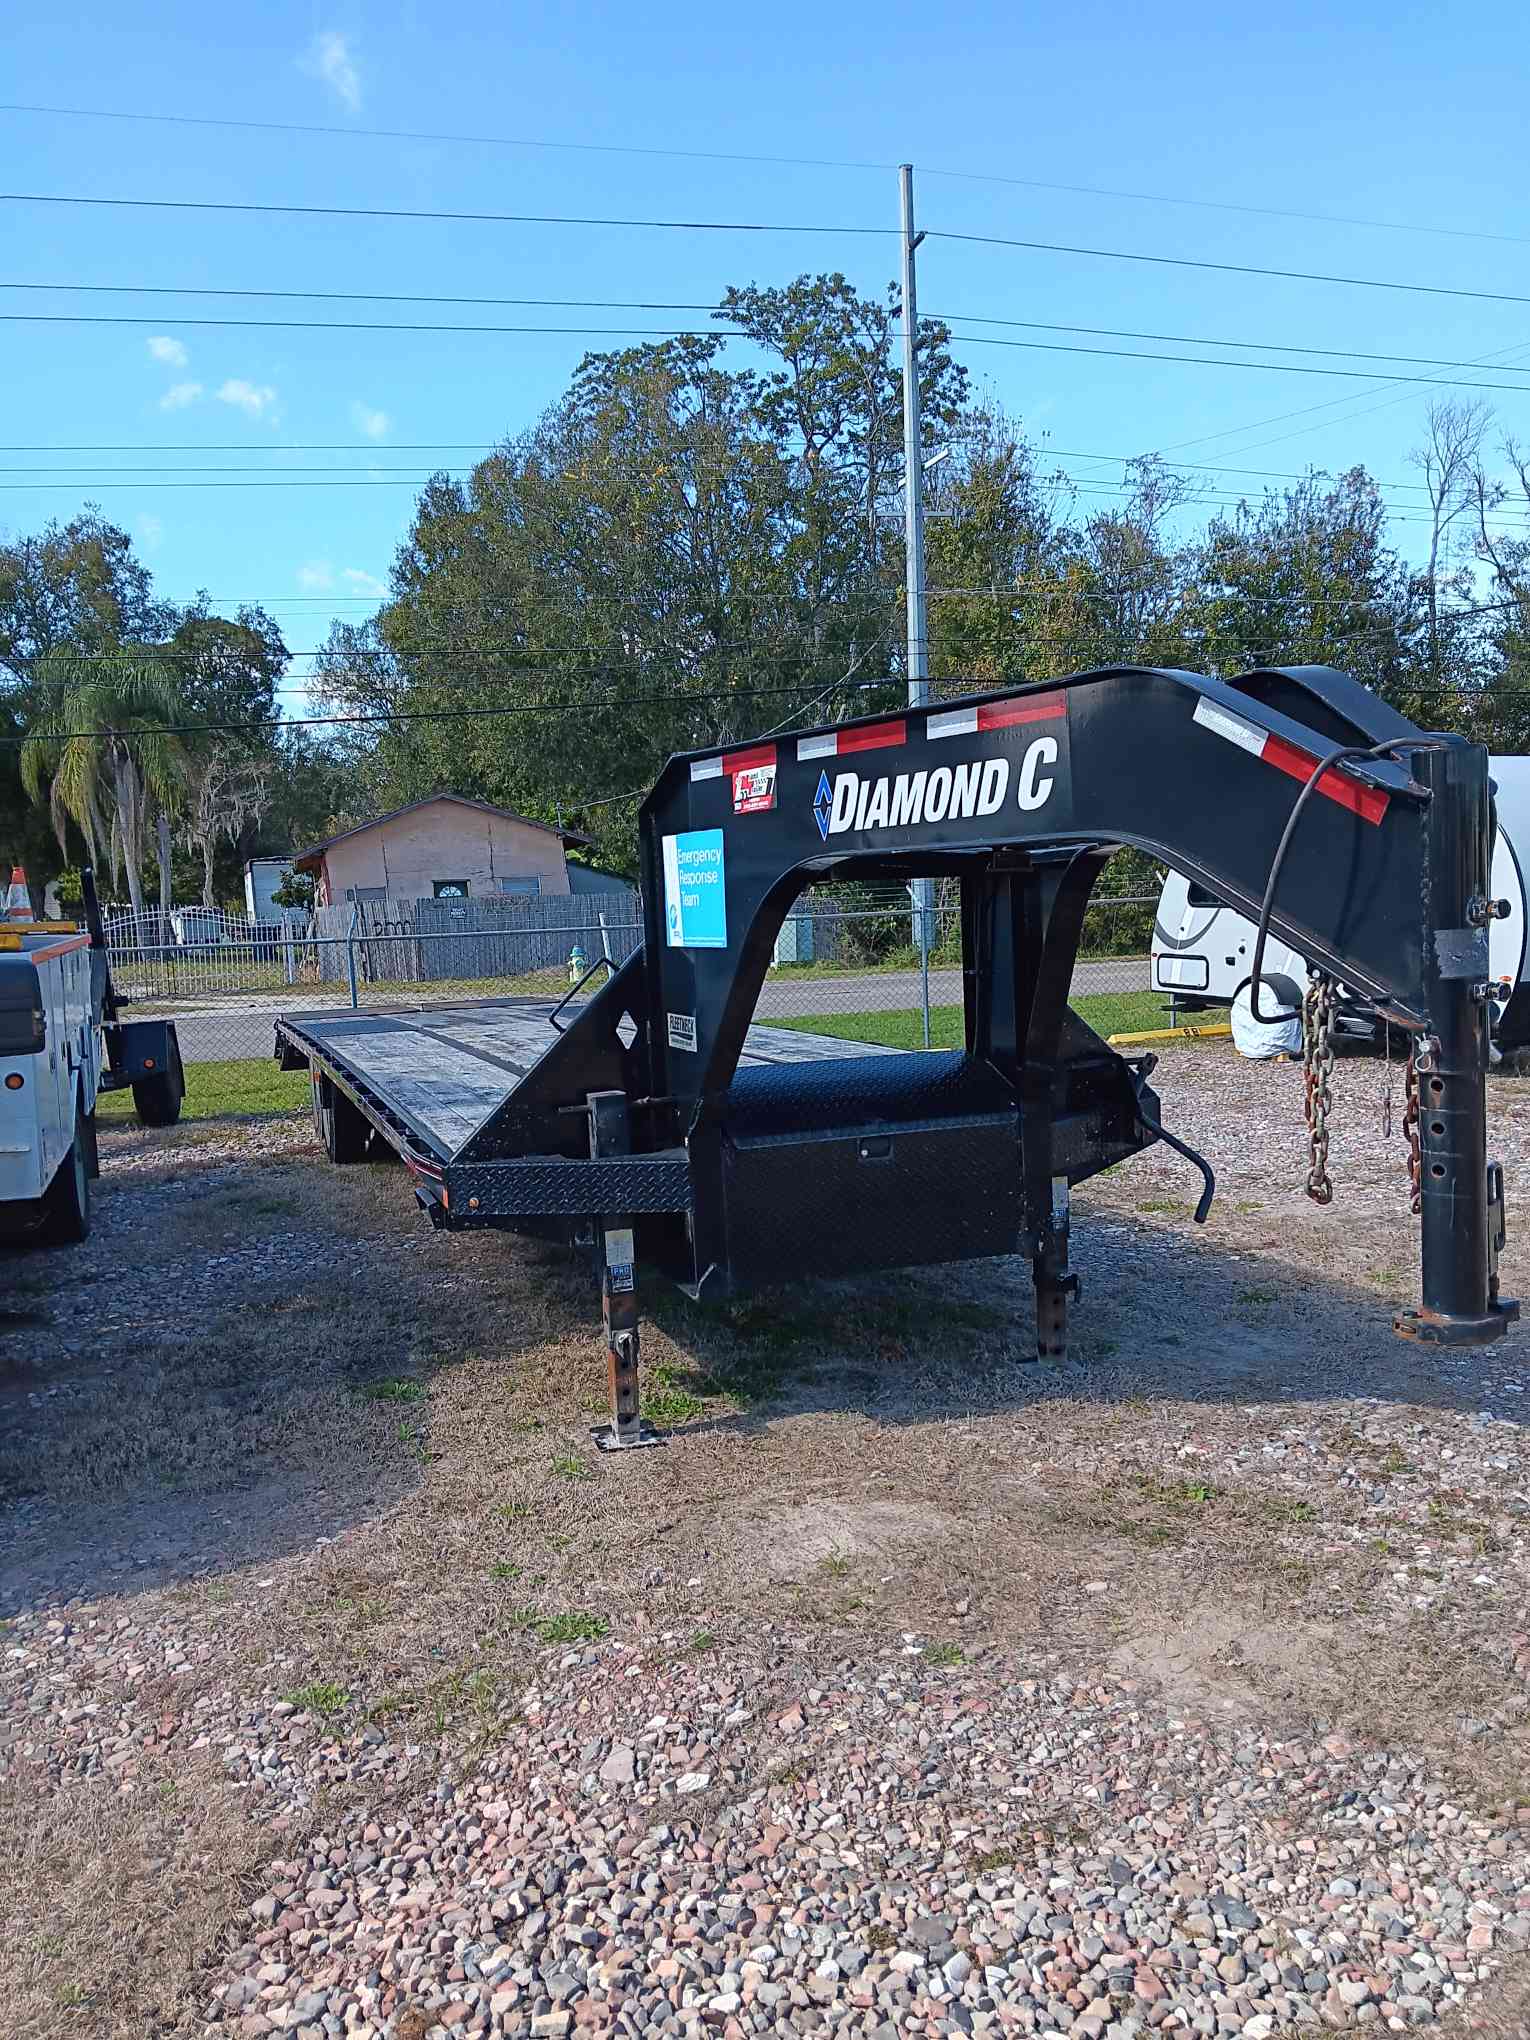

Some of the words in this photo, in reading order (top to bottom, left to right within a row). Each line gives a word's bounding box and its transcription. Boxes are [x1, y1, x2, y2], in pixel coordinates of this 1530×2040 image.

[828, 758, 1010, 834] DIAMOND
[1017, 736, 1059, 812] C
[677, 848, 722, 867] Emergency
[679, 870, 719, 888] Response
[681, 890, 701, 907] Team
